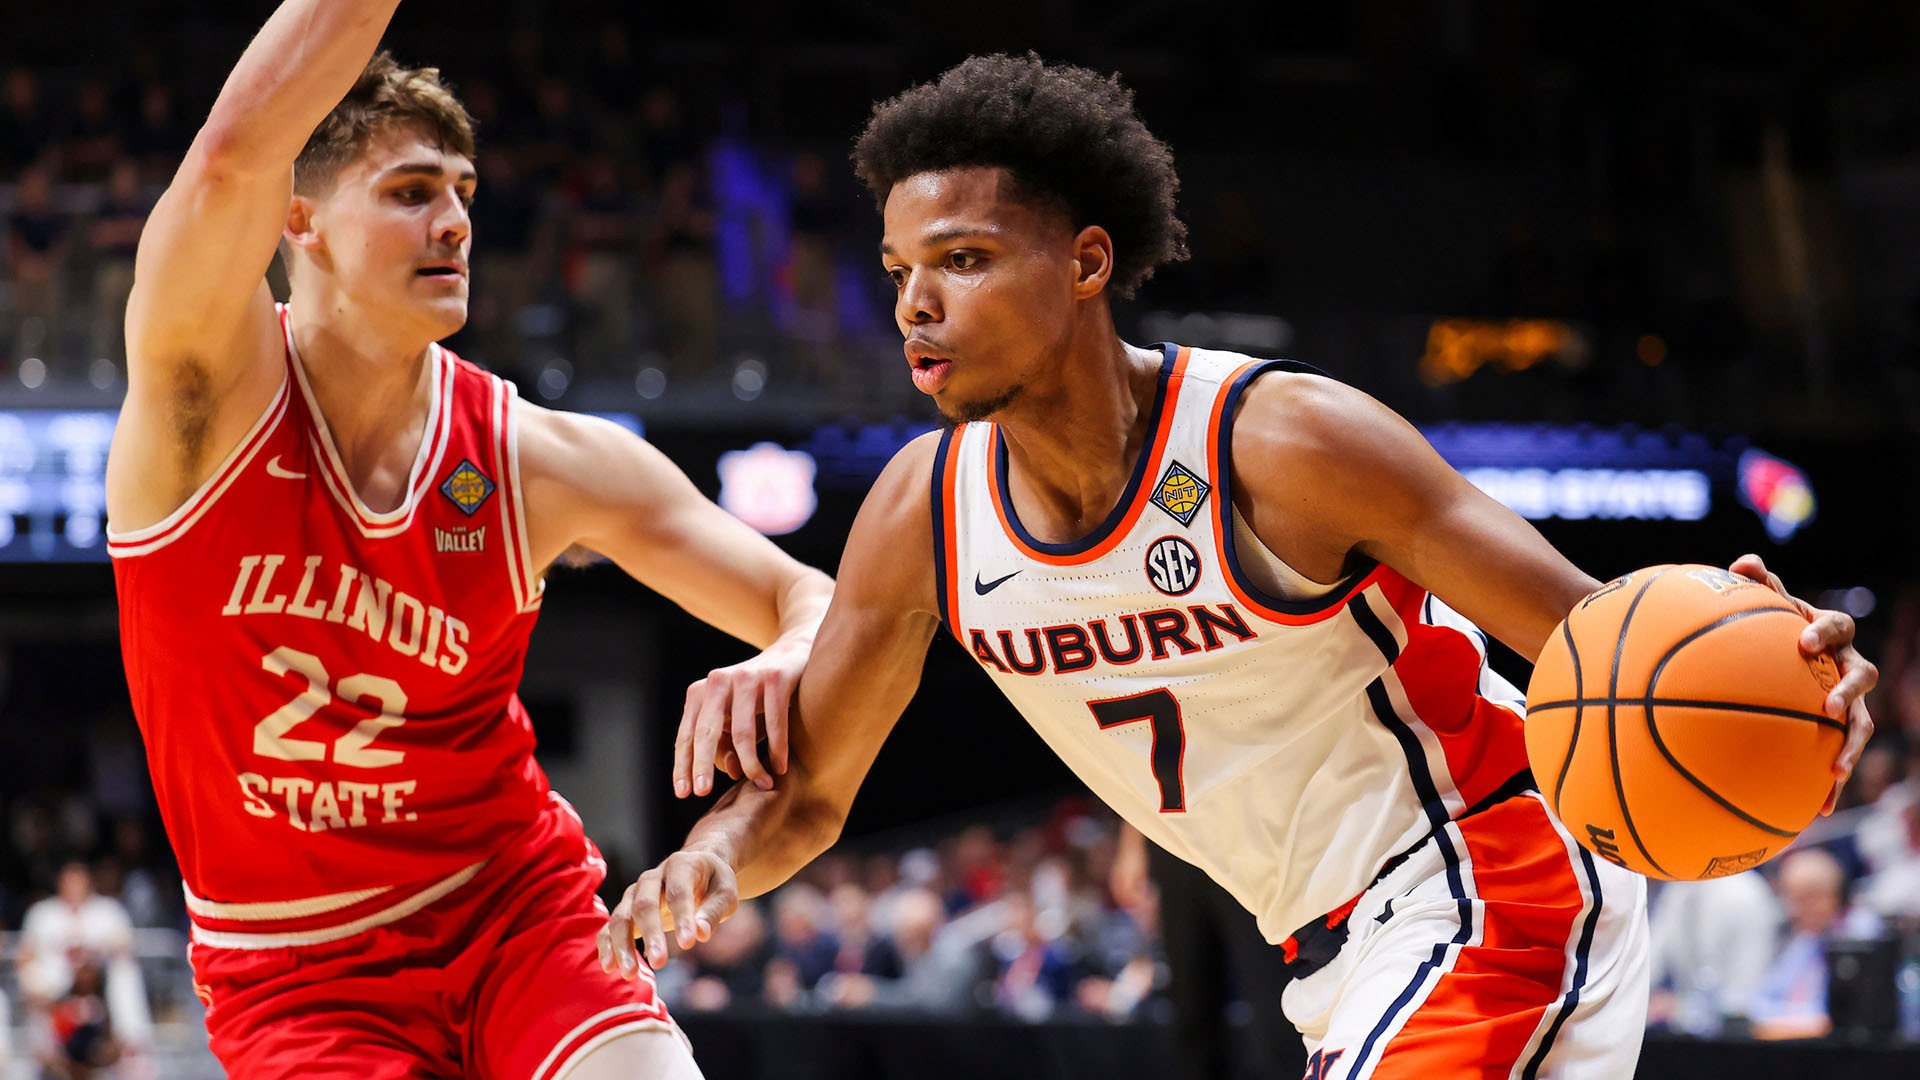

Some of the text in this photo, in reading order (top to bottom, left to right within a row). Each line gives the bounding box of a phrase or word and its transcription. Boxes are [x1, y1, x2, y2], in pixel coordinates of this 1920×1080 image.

[1165, 485, 1196, 502] NIT
[434, 524, 487, 553] VALLEY
[1148, 540, 1197, 592] SEC
[221, 554, 470, 676] ILLINOIS
[969, 603, 1259, 676] AUBURN
[253, 645, 409, 769] 22
[1086, 687, 1187, 813] 7
[237, 772, 419, 832] STATE
